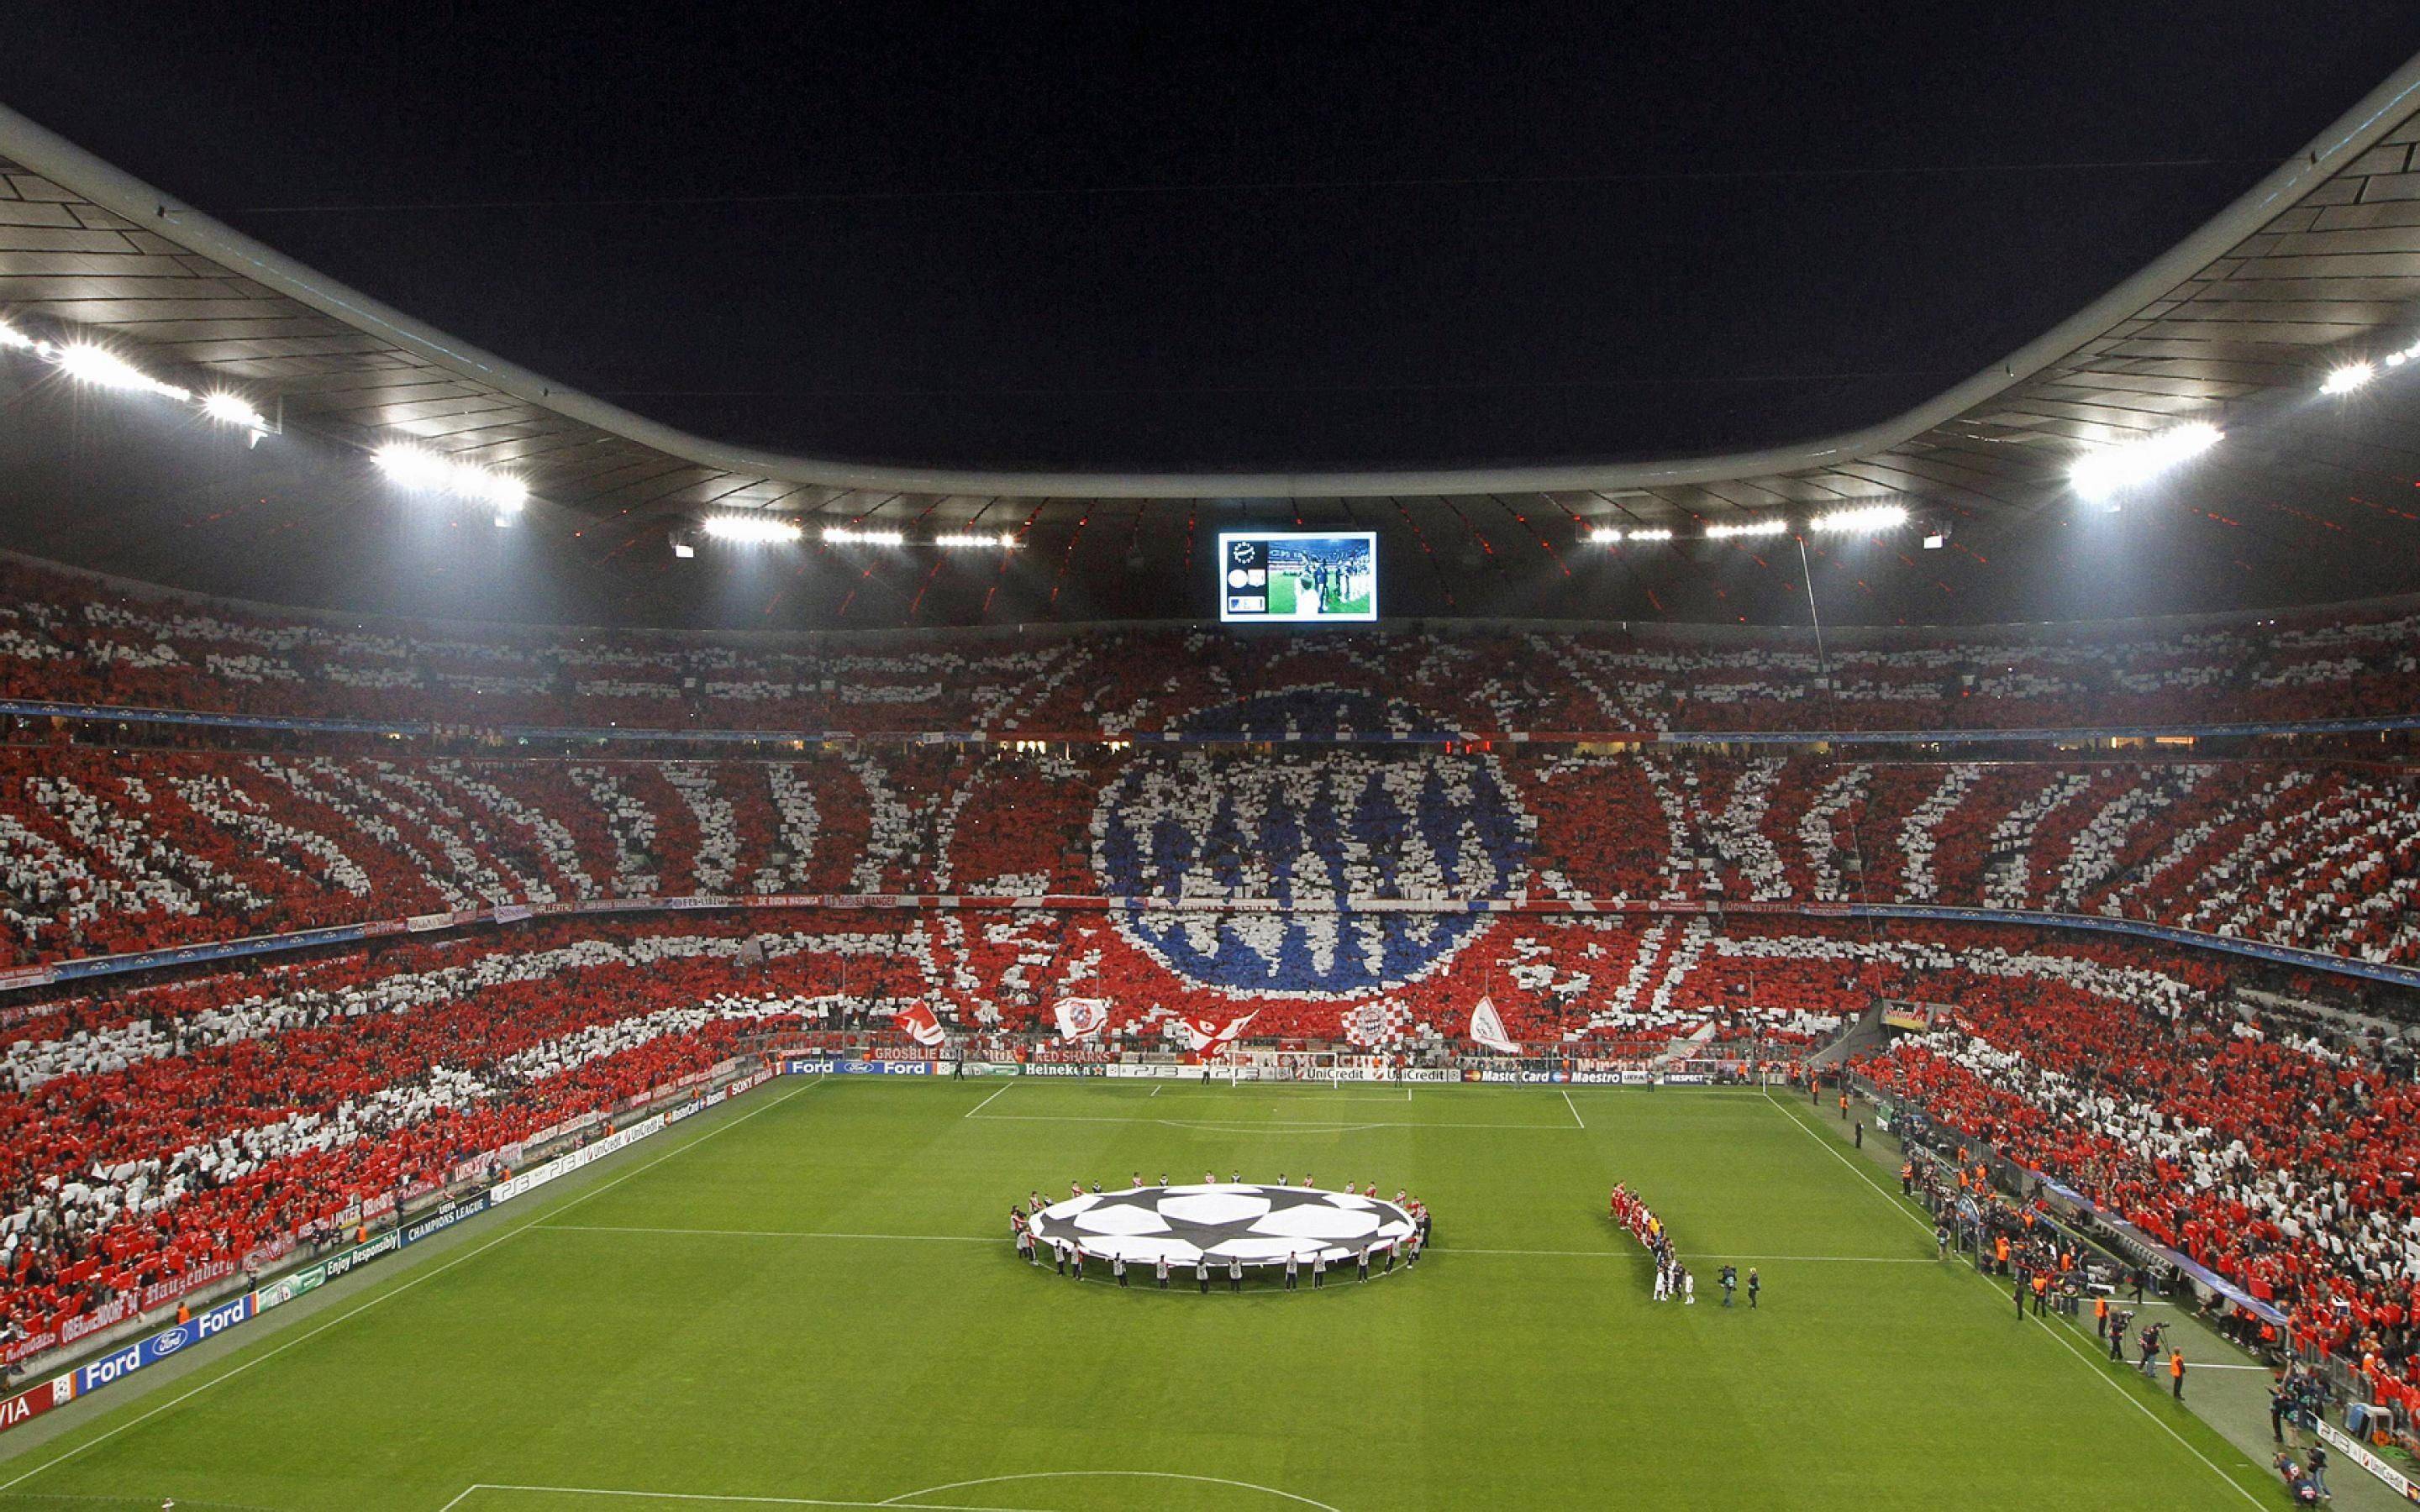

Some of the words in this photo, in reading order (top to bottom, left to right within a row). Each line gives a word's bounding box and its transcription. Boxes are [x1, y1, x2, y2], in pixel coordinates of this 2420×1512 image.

[1035, 1052, 1059, 1062] RED
[1063, 1051, 1110, 1063] SHARKS
[792, 1061, 834, 1074] Ford
[884, 1061, 924, 1074] Ford
[1307, 1068, 1363, 1079] UniCredit
[1387, 1068, 1444, 1080] UiCredit
[1572, 1071, 1620, 1083] Maestro
[732, 1076, 753, 1095] SONY
[630, 1116, 659, 1140] UniCredit
[592, 1136, 622, 1157] UniCredit
[550, 1154, 576, 1176] PS3
[503, 1175, 530, 1197] PS3
[439, 1200, 457, 1215] UEFA
[408, 1211, 455, 1242] CHAMPIONS
[455, 1198, 484, 1221] LEAGUE
[327, 1255, 351, 1276] Enjoy
[352, 1235, 397, 1264] Responsibly
[199, 1298, 245, 1338] Ford
[86, 1343, 140, 1390] Ford
